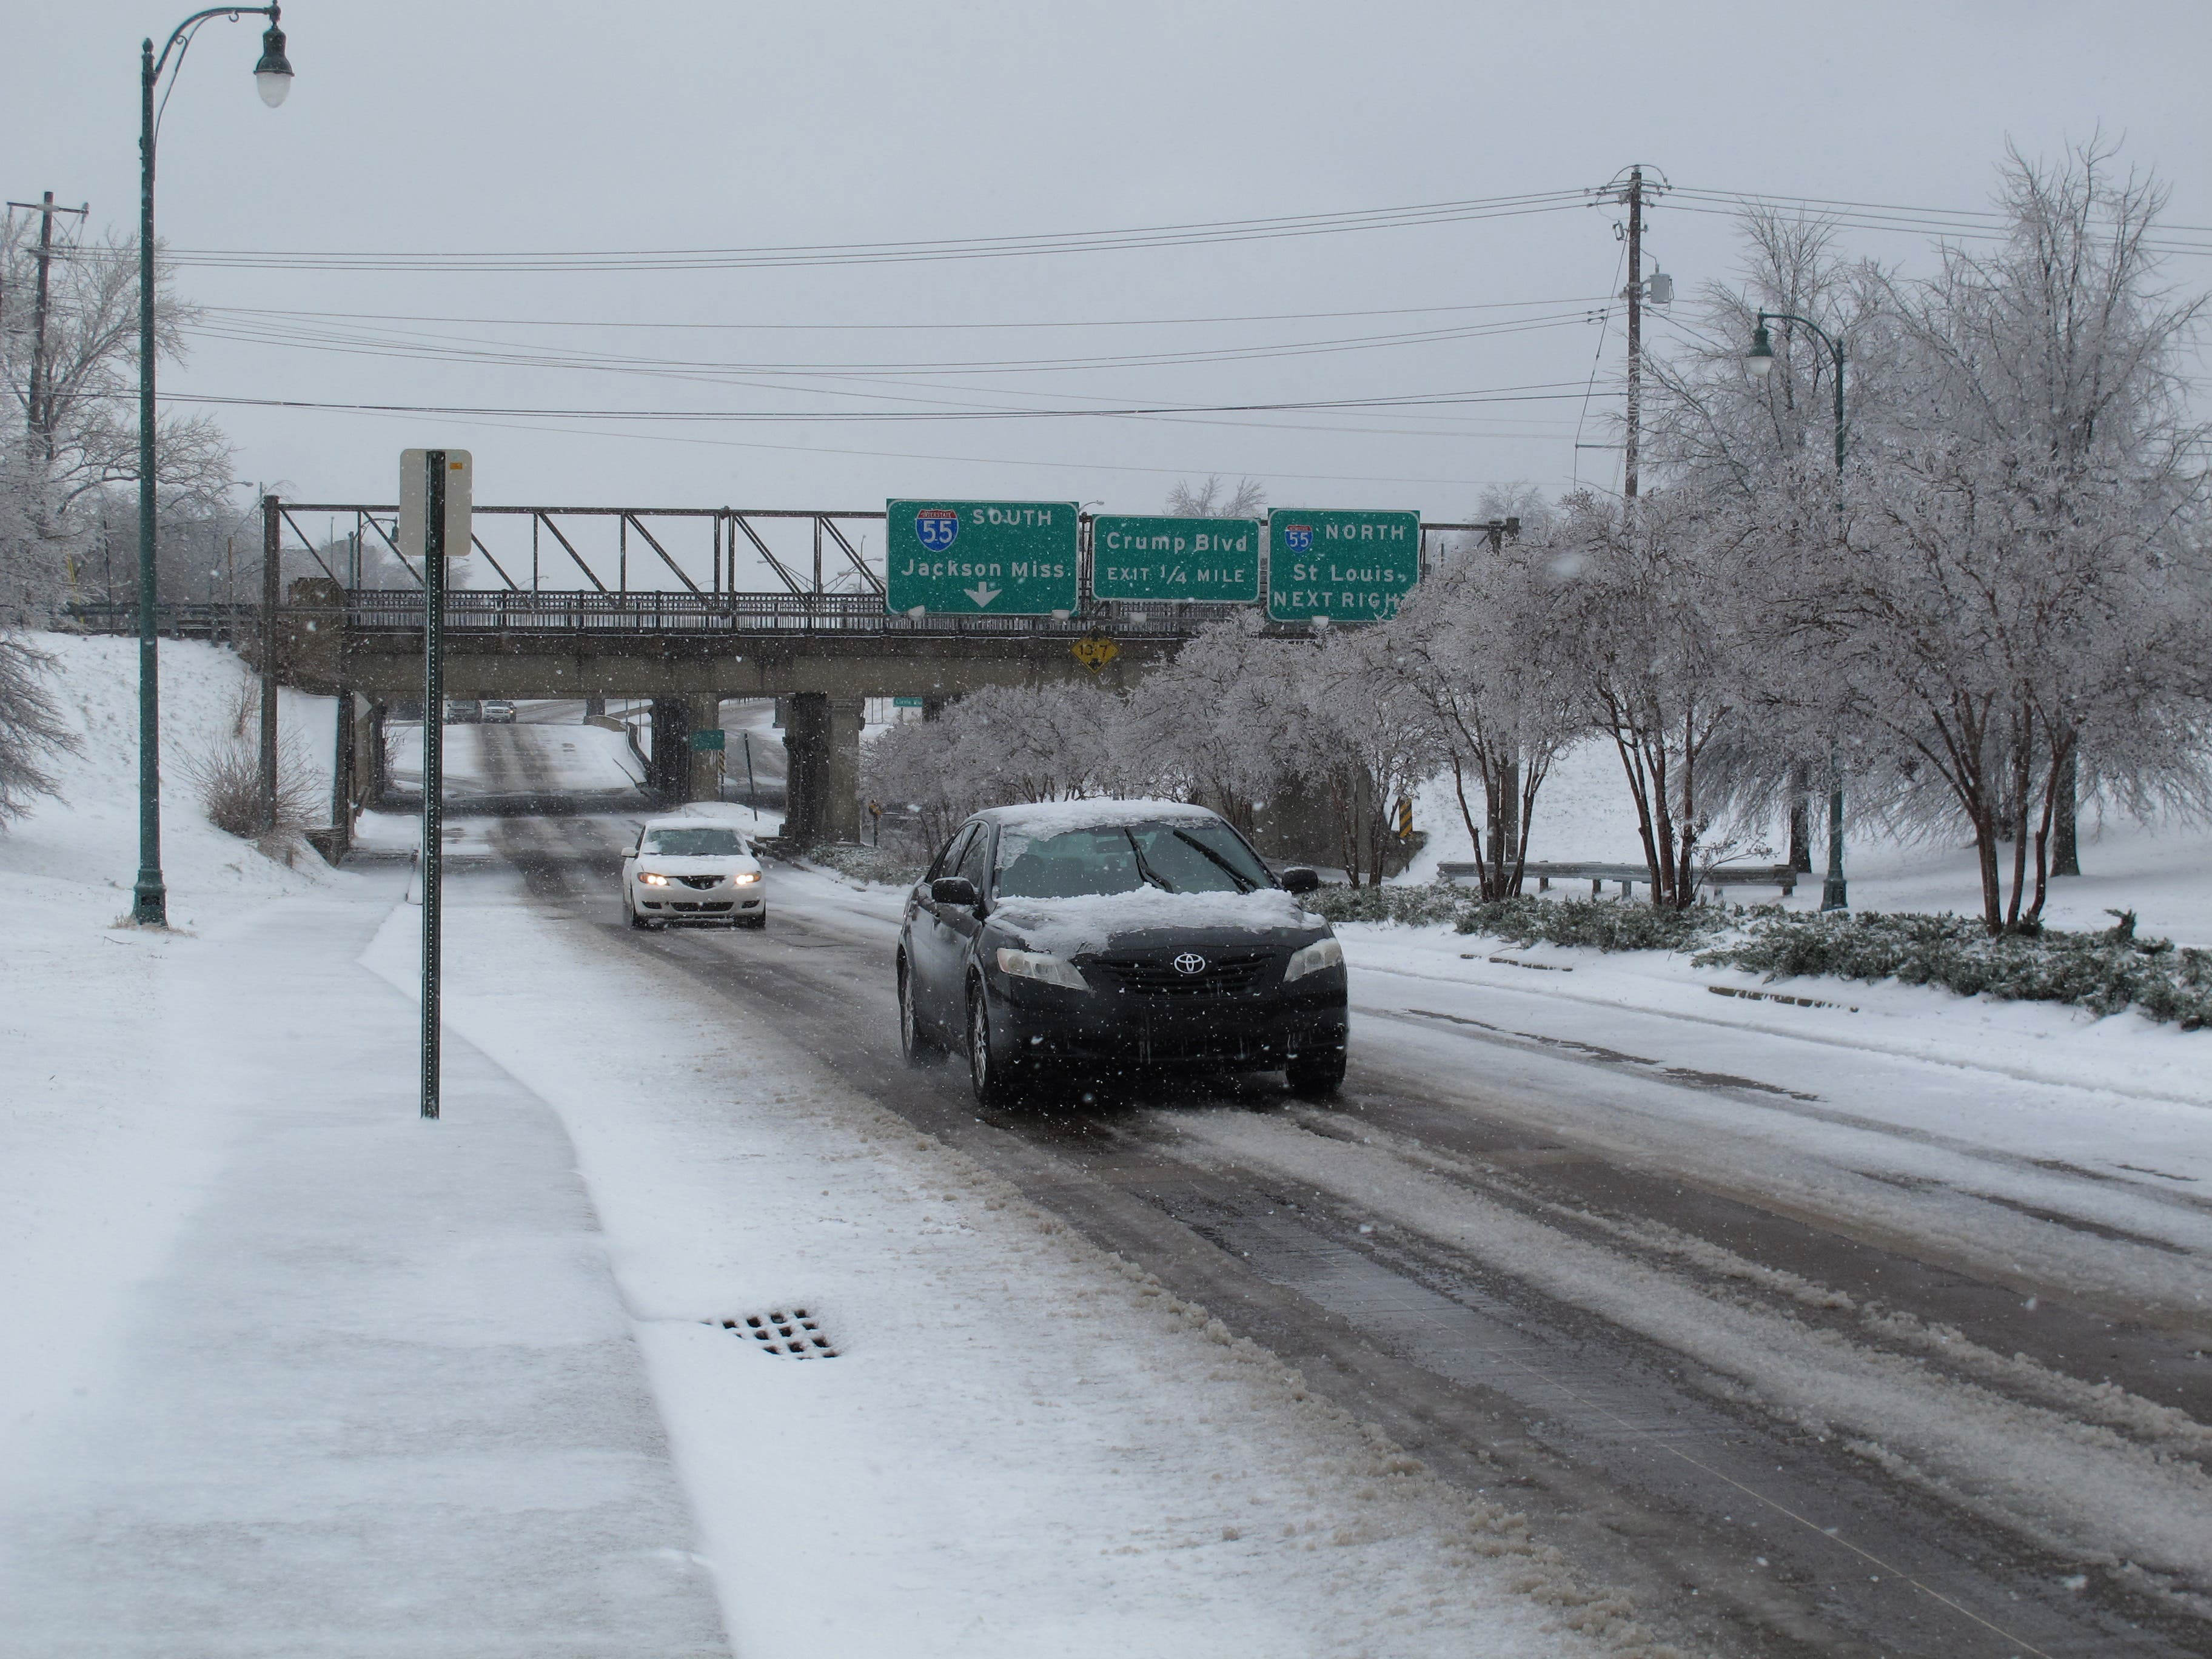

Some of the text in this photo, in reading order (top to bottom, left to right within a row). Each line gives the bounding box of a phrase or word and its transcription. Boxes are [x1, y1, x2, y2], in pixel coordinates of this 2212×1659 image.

[973, 509, 1051, 526] SOUTH
[923, 520, 952, 543] 55
[1290, 532, 1309, 548] 55
[1326, 524, 1404, 540] NORTH
[1107, 532, 1247, 554] Crump Blvd
[901, 558, 1064, 578] Jackson Miss
[1107, 567, 1149, 581] EXIT
[1198, 569, 1244, 583] MILE
[1293, 563, 1394, 582] St Louis
[1273, 591, 1407, 609] NEXT RIGH
